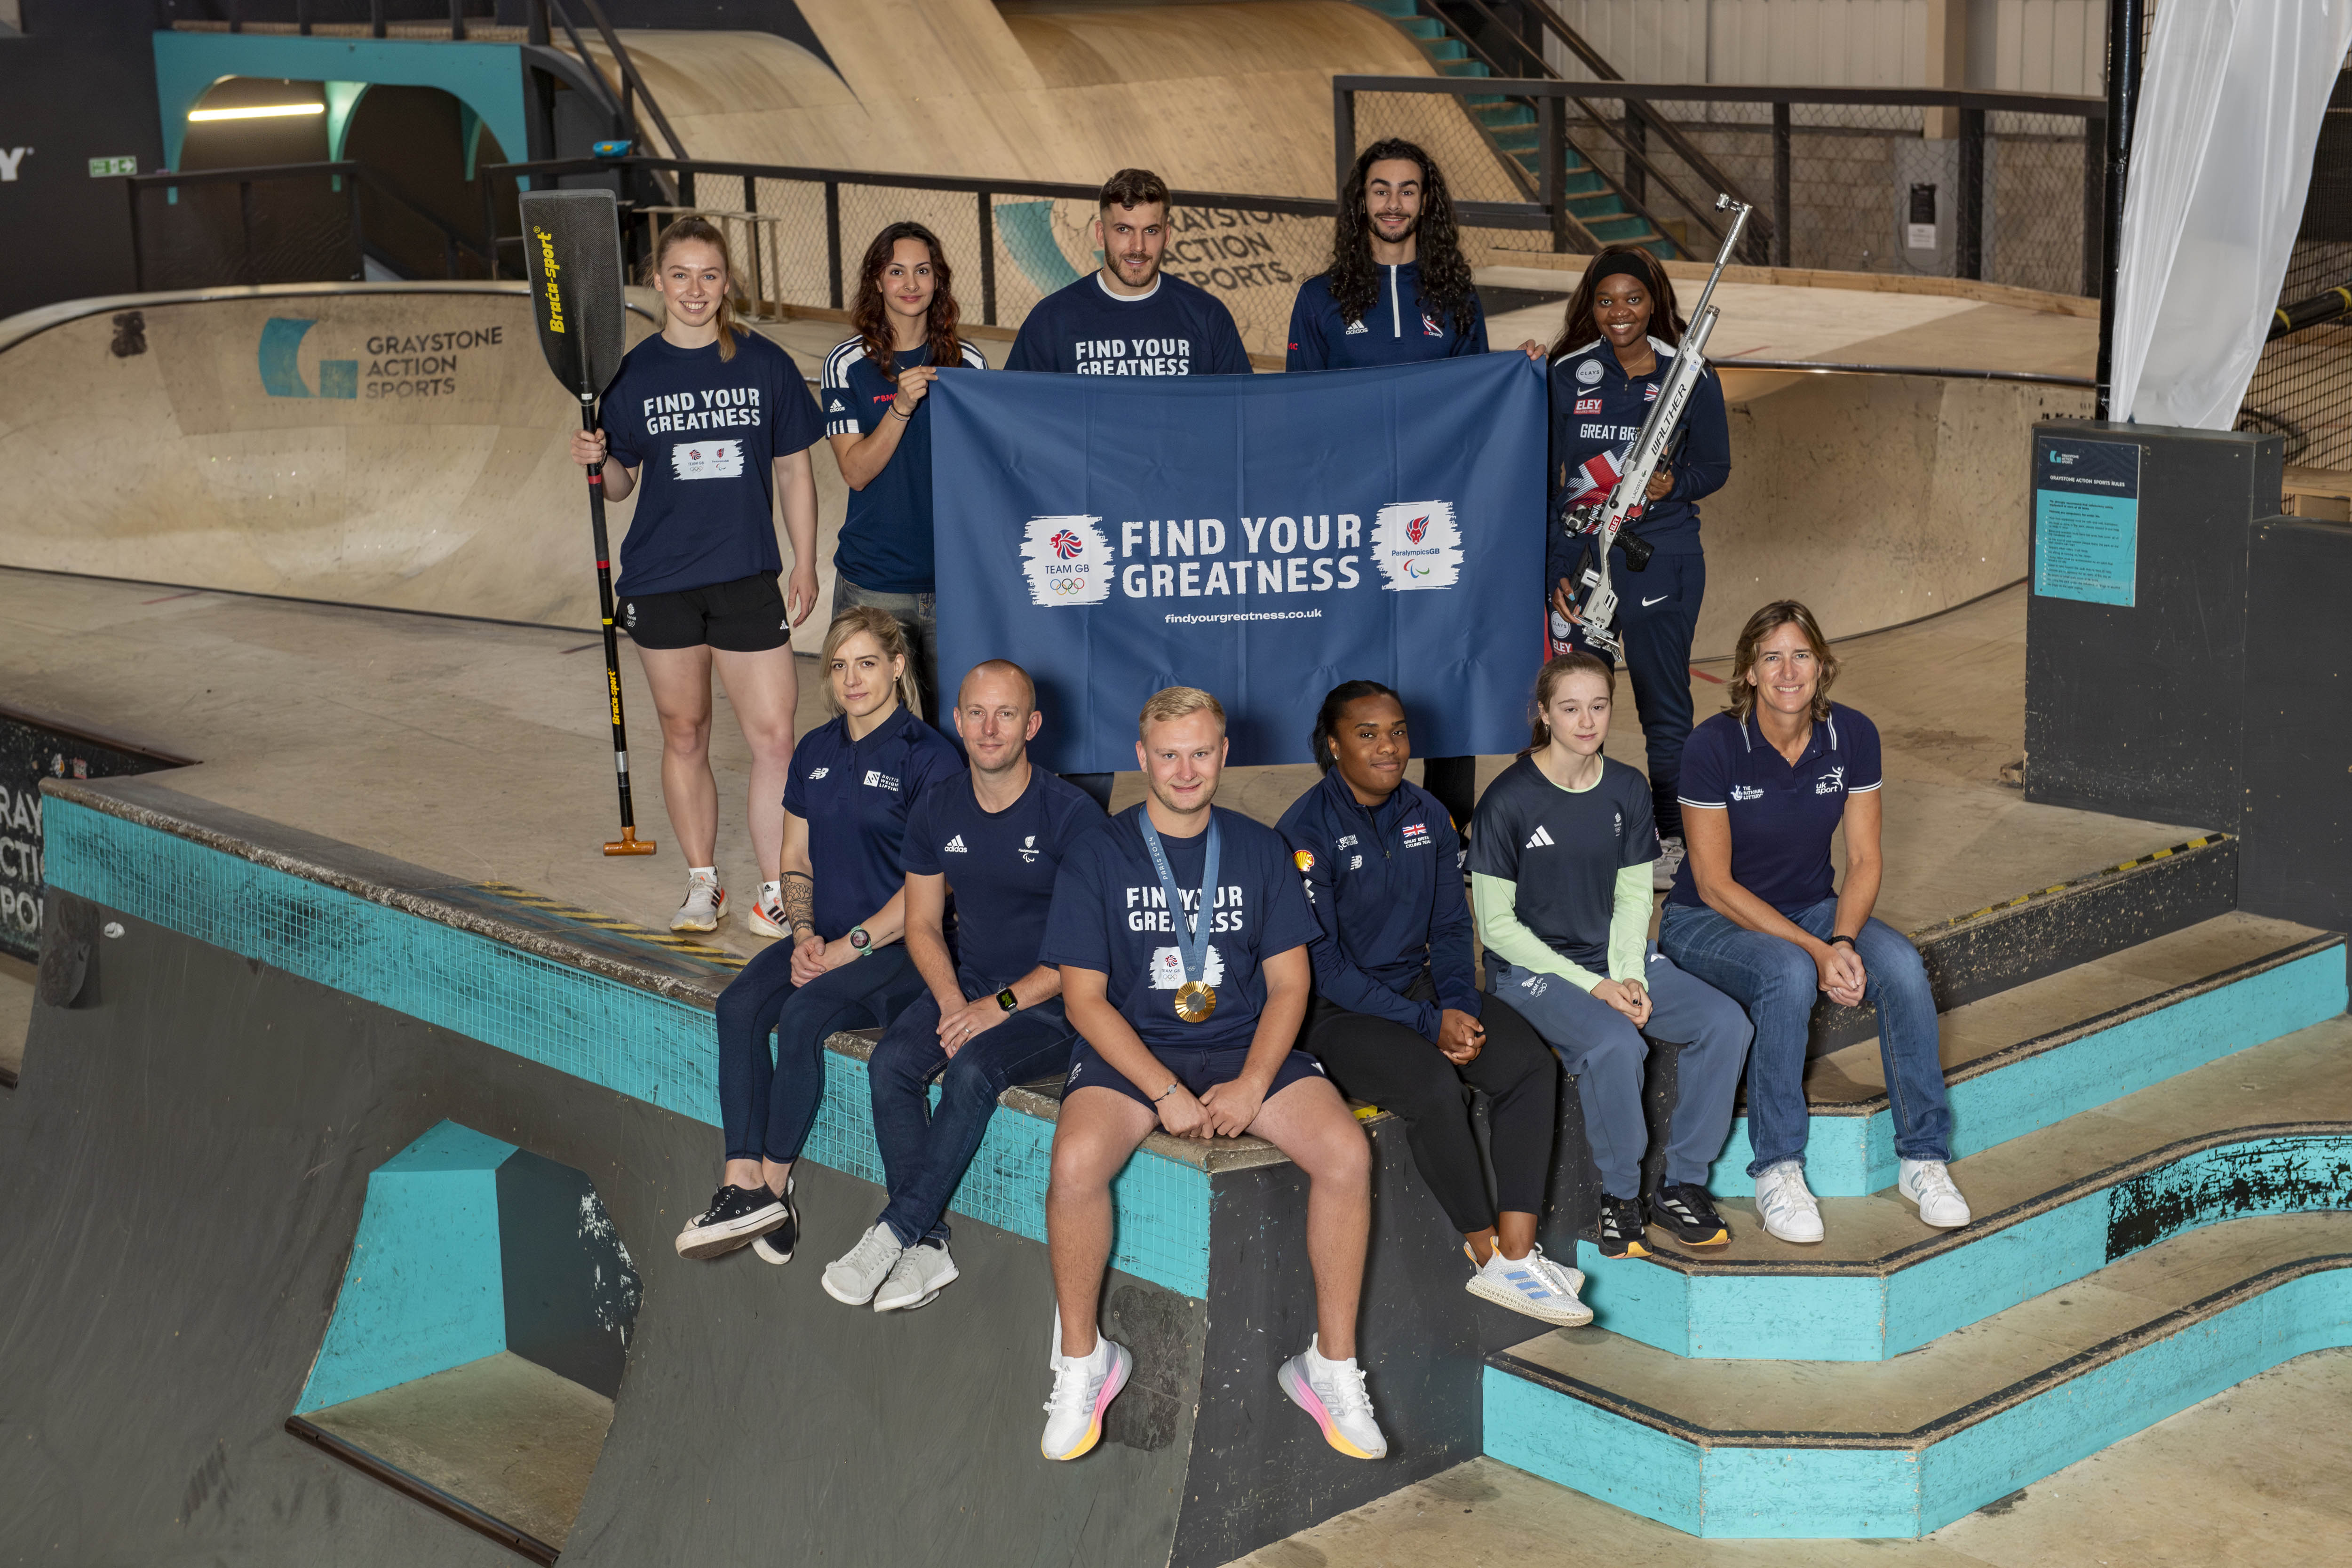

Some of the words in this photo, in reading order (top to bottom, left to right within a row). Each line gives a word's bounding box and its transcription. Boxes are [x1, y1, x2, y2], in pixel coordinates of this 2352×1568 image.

[1160, 232, 1275, 266] ACTION
[366, 326, 502, 355] GRAYSTONE
[1076, 339, 1126, 360] FIND
[1132, 339, 1190, 357] YOUR
[367, 355, 456, 377] ACTION
[1077, 358, 1190, 376] GREATNESS
[366, 378, 455, 399] SPORTS
[644, 393, 695, 417] FIND
[700, 388, 760, 409] YOUR
[1576, 399, 1601, 410] ELEY
[646, 408, 761, 435] GREATNESS
[1651, 383, 1686, 455] WALTHER
[1580, 423, 1617, 440] GREAT
[1632, 478, 1644, 499] LACOSTE
[1610, 517, 1620, 531] ELEY
[1122, 518, 1226, 557] FIND
[1241, 514, 1362, 554] YOUR
[1392, 548, 1440, 557] ParalympicsGB
[1045, 565, 1072, 574] TEAM
[1075, 564, 1089, 573] GB
[1122, 555, 1360, 598] GREATNESS
[1165, 608, 1322, 624] findyourgreatness.co.uk
[1553, 638, 1572, 653] ELEY
[879, 783, 898, 792] LIFTIN
[881, 779, 899, 787] WEIGH
[1815, 785, 1838, 795] sport
[1149, 837, 1160, 857] 2024
[1156, 858, 1168, 880] PARIS
[1127, 887, 1182, 908] FIN
[1530, 983, 1539, 996] TEAM
